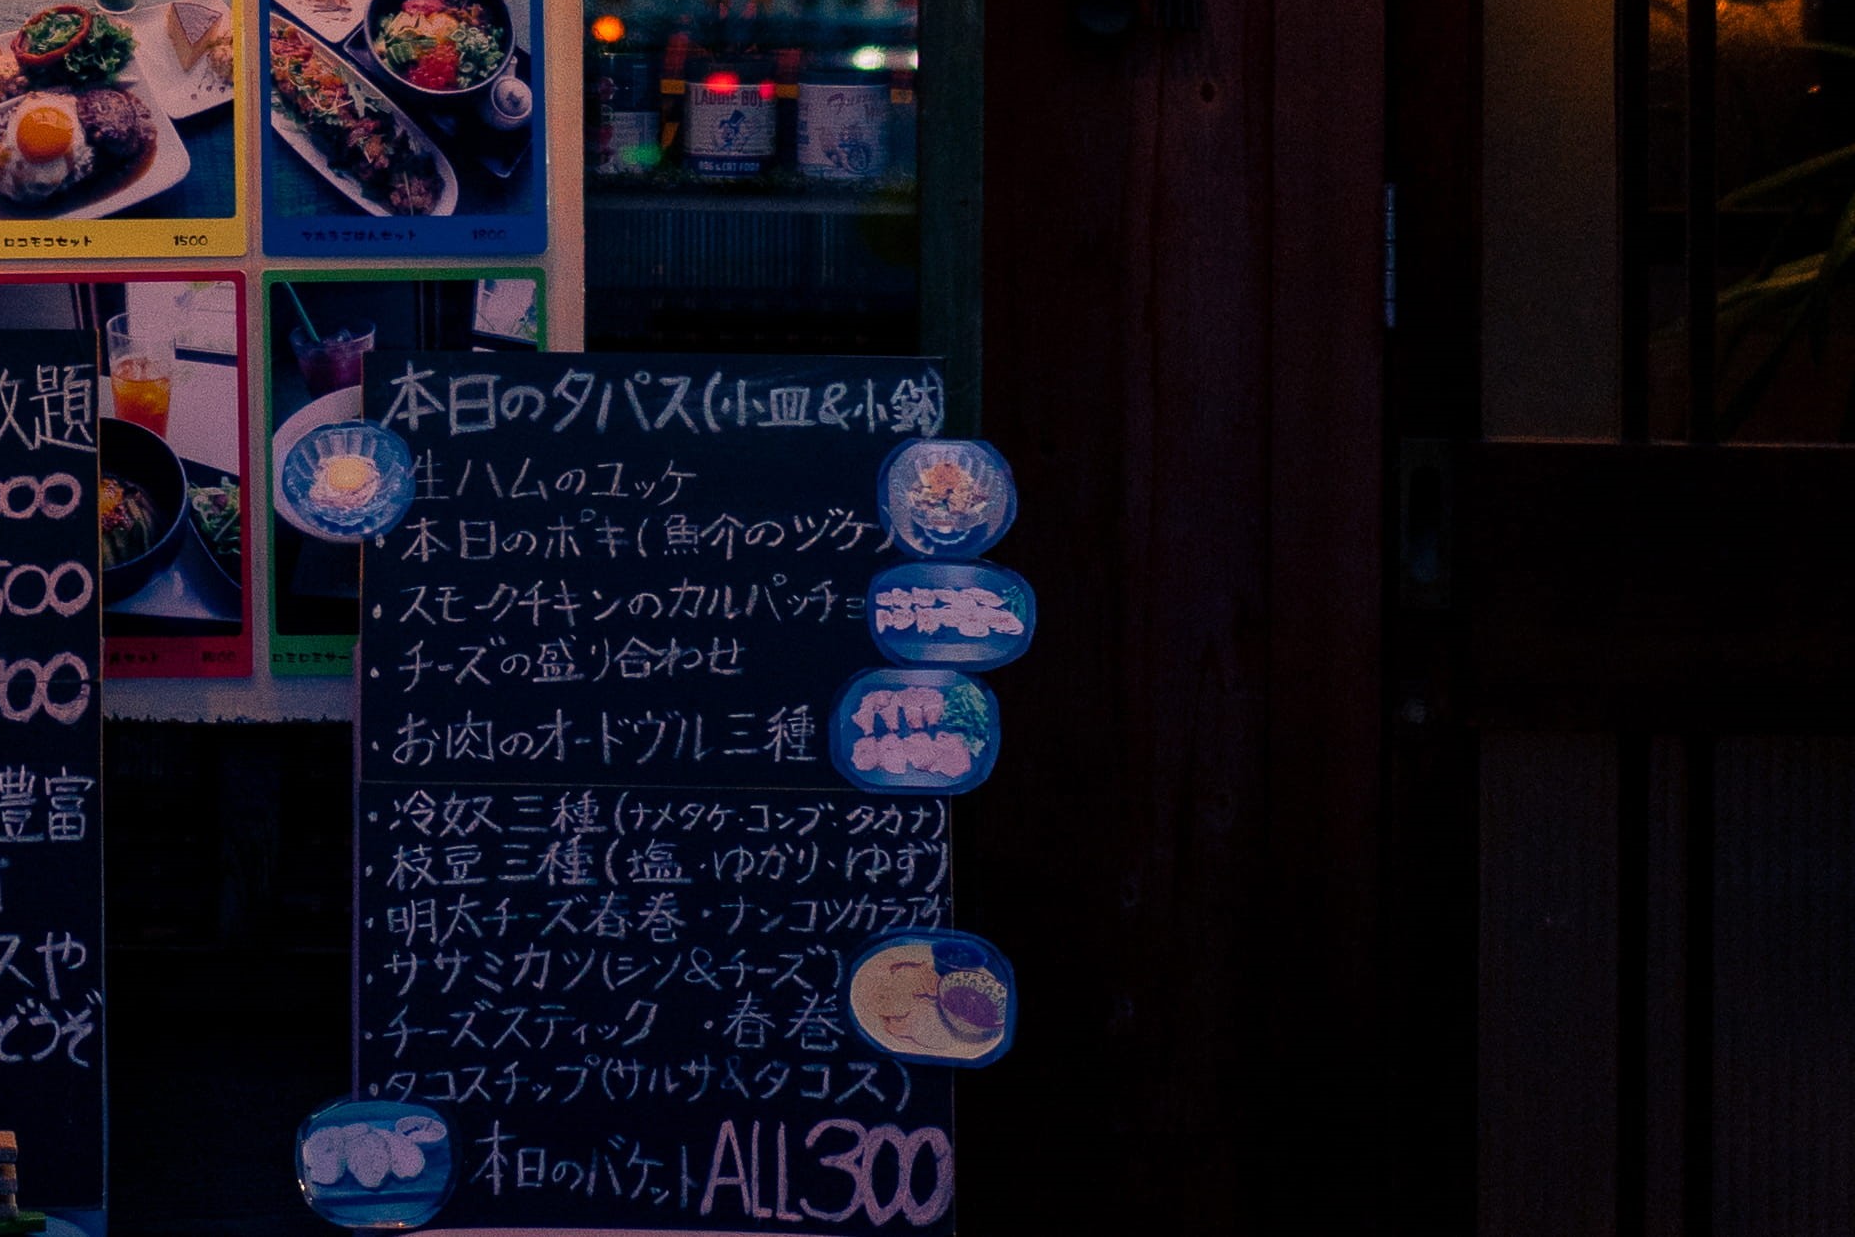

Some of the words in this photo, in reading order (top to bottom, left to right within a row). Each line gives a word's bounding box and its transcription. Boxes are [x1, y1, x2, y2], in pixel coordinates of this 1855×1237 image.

[3, 235, 93, 248] ロコモコセット
[173, 234, 209, 247] 1500
[469, 1119, 701, 1211] 本日のバケット
